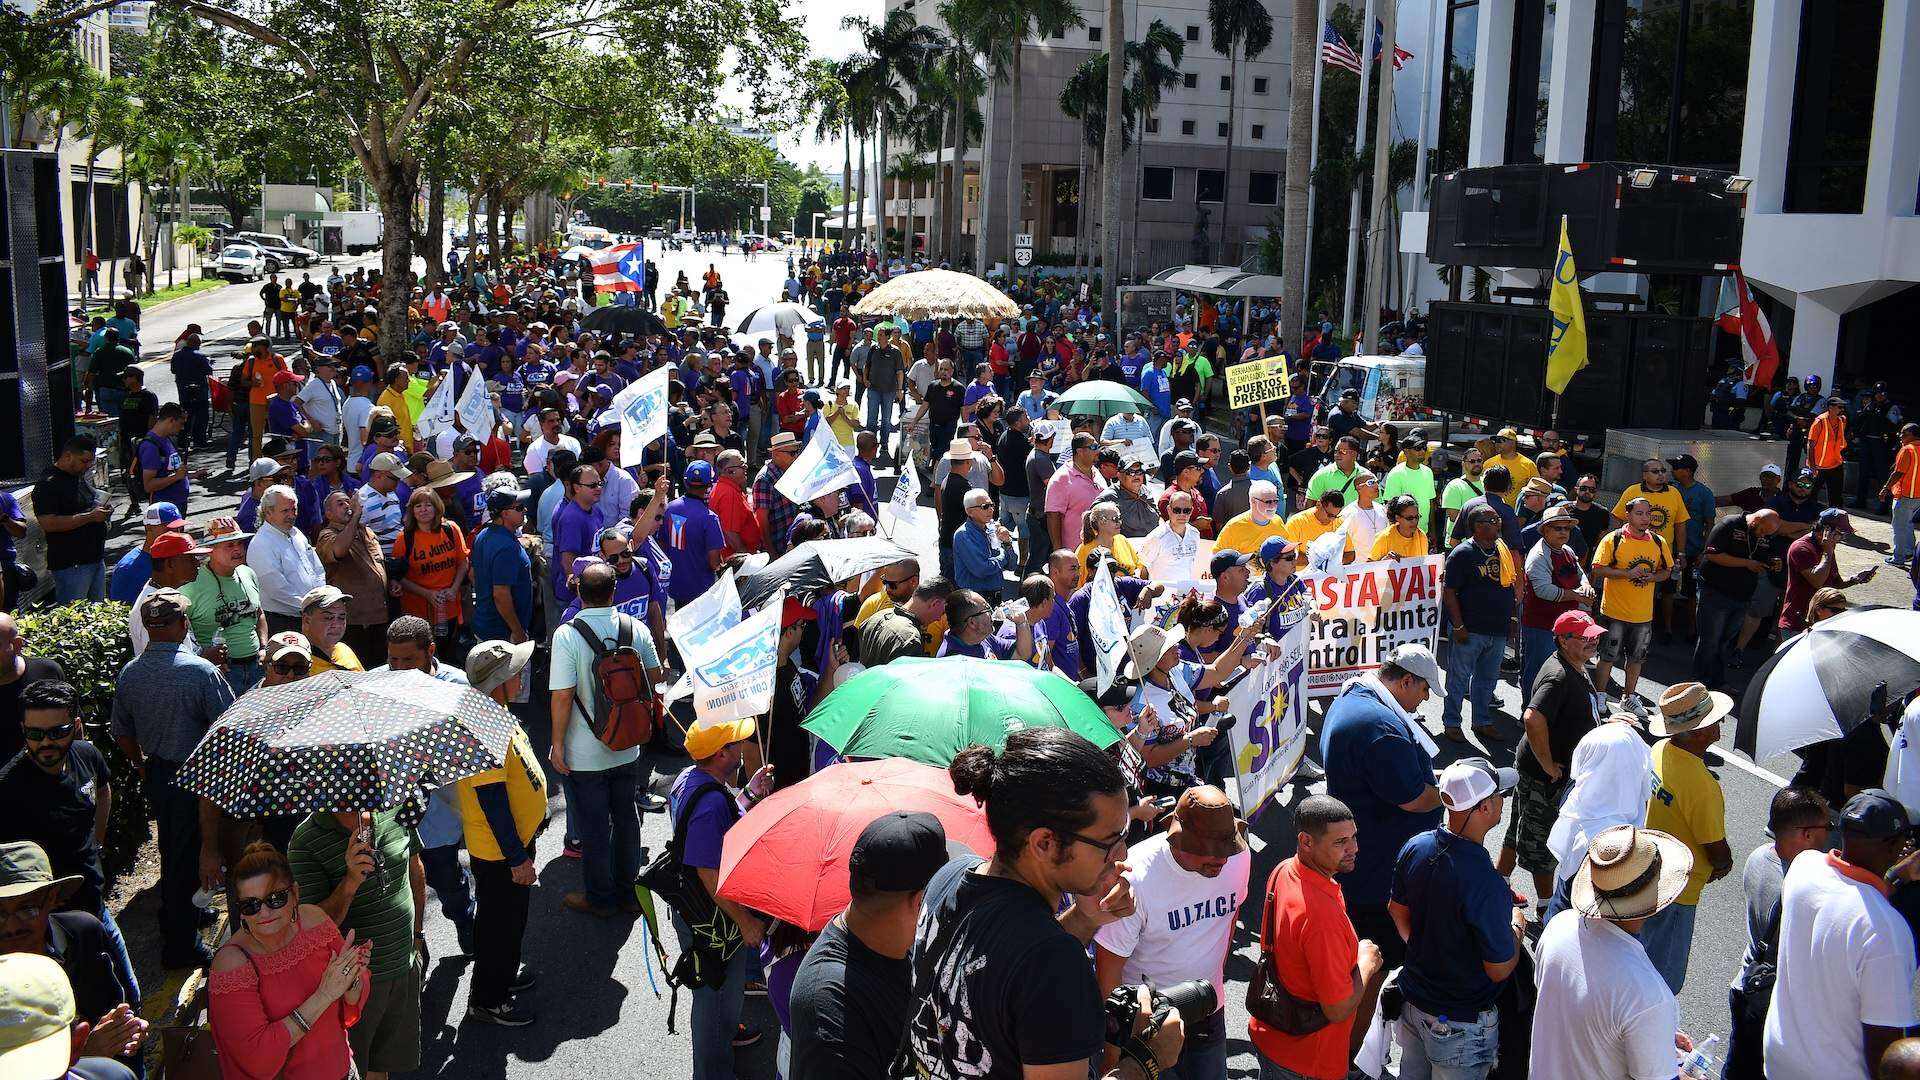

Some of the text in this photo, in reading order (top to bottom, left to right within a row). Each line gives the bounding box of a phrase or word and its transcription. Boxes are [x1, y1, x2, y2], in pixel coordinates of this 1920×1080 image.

[1017, 236, 1031, 245] INT
[1017, 251, 1031, 261] 23
[1233, 384, 1288, 406] PRESENTE
[1235, 376, 1282, 396] PUERTOS
[413, 547, 426, 561] La
[421, 556, 456, 575] Miente
[1304, 571, 1380, 612] ASTA
[1387, 564, 1437, 604] YA!
[1353, 618, 1367, 637] la
[1371, 603, 1439, 634] Junta
[1308, 636, 1367, 670] ntrol
[1249, 658, 1304, 774] SPT
